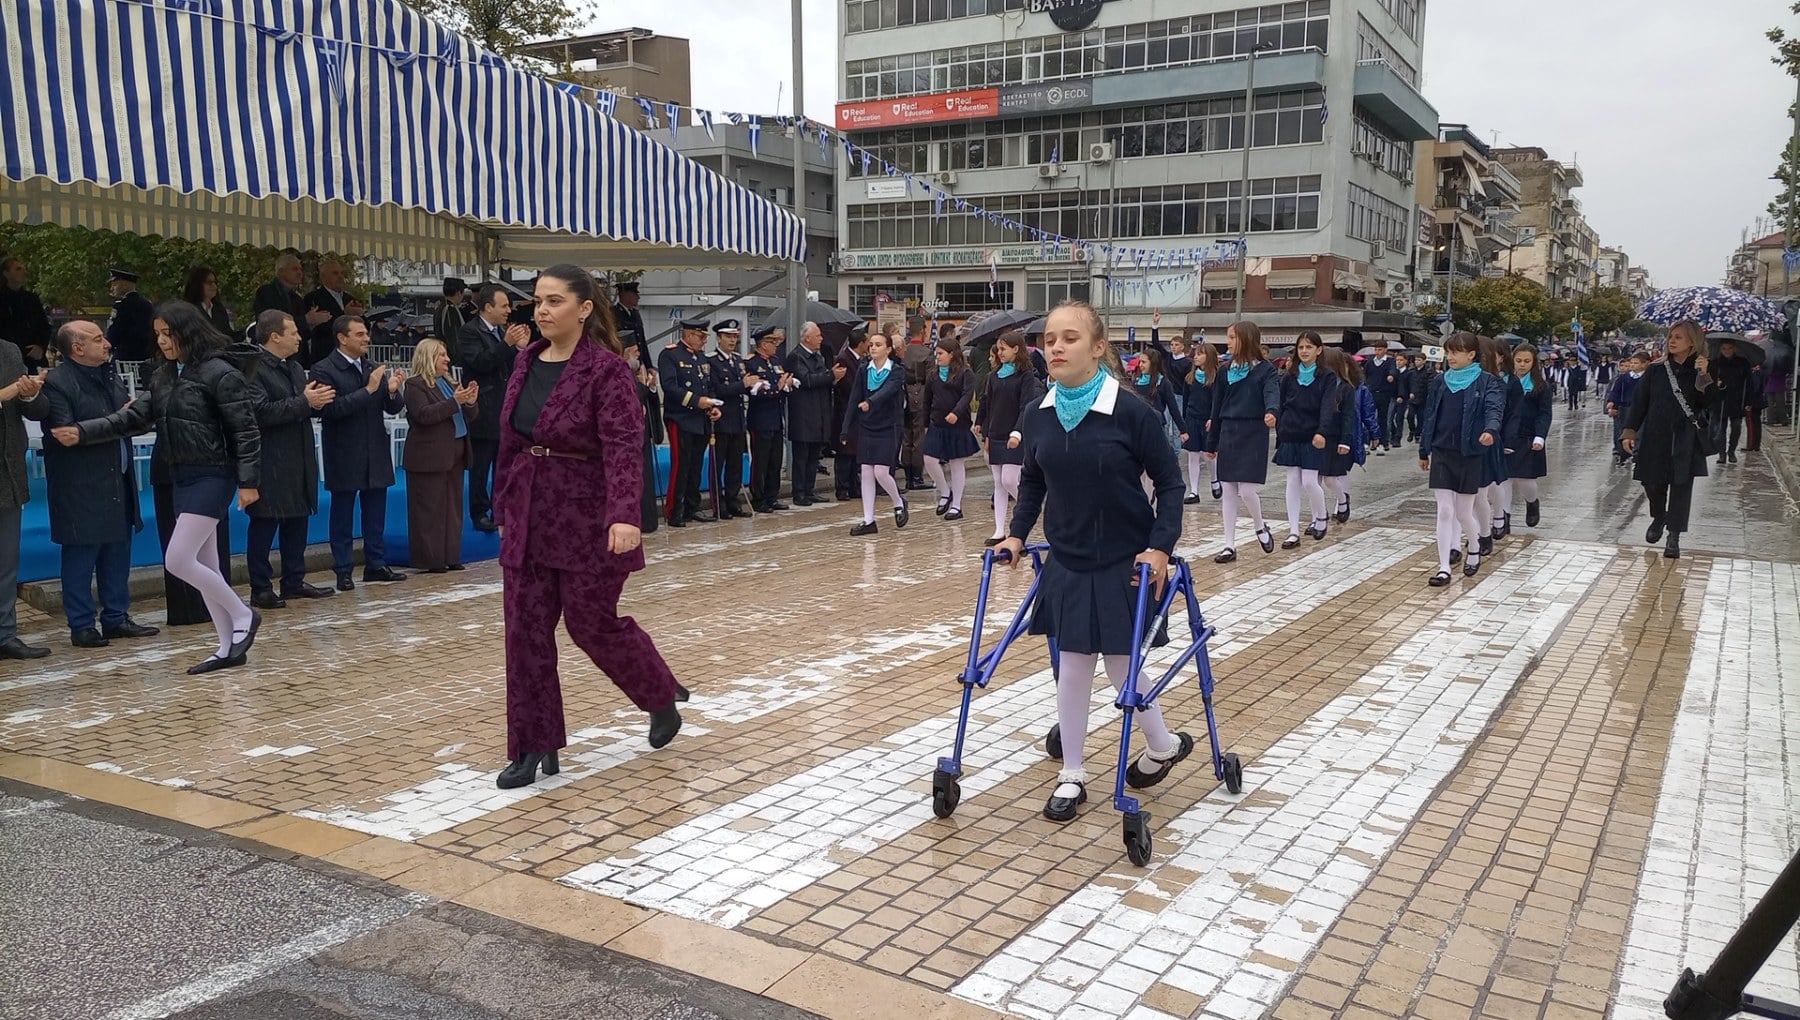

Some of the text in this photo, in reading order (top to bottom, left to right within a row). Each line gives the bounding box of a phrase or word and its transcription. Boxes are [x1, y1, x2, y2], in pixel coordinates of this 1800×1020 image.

[1064, 88, 1089, 100] ECDL
[954, 96, 972, 105] Real
[1002, 99, 1028, 107] ΚΕΝΤΡΟ
[901, 102, 918, 111] Real
[958, 103, 989, 112] Education
[850, 108, 866, 116] Real
[904, 109, 934, 117] Education
[853, 114, 881, 123] Education
[920, 298, 950, 308] coffee
